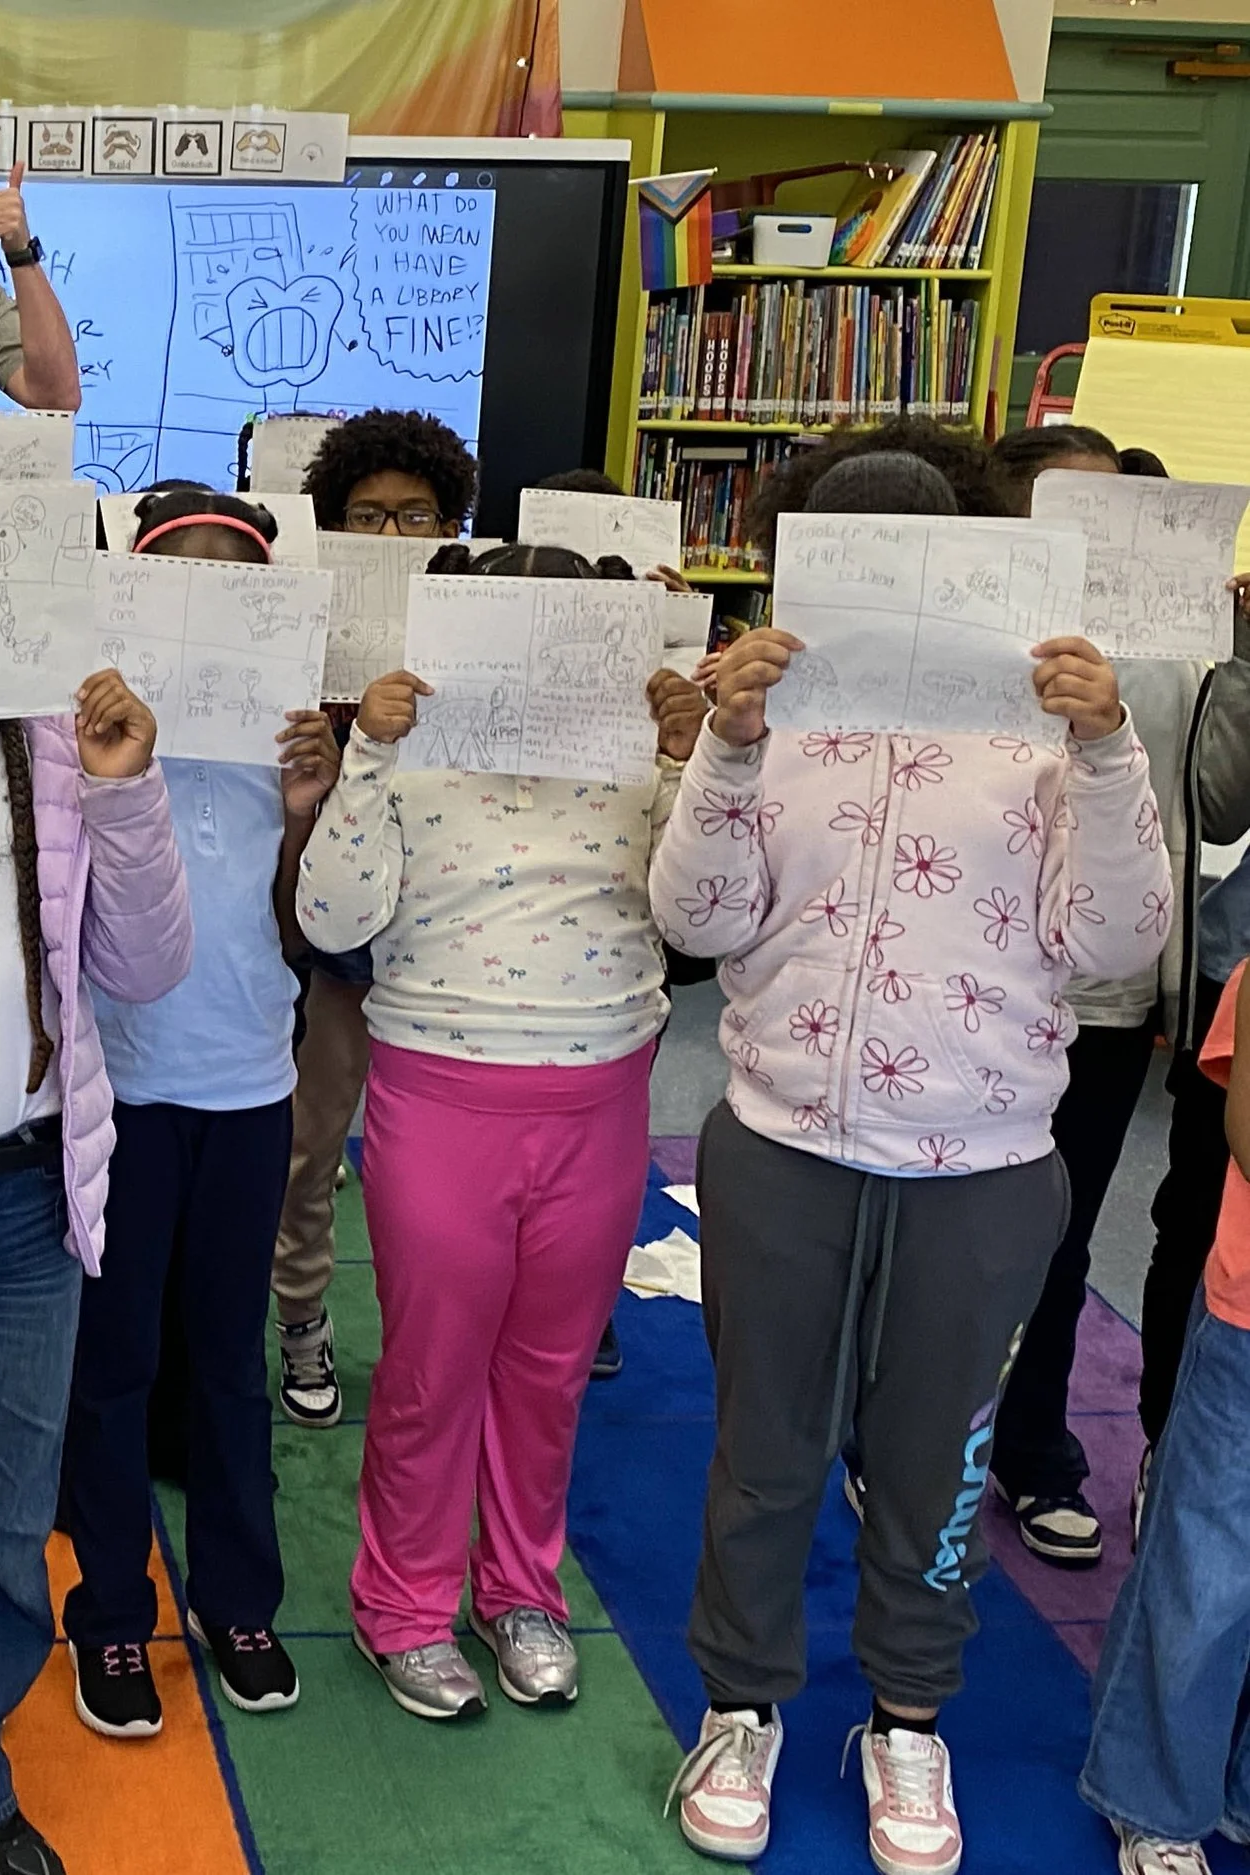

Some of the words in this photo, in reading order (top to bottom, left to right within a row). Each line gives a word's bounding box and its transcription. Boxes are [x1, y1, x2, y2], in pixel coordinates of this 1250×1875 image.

[375, 192, 443, 216] WHAT
[455, 195, 478, 214] DO
[374, 223, 410, 243] YOU
[421, 224, 481, 247] MEAN
[374, 254, 379, 273] I
[393, 251, 468, 278] HAVE
[371, 286, 385, 306] A
[397, 281, 480, 307] LIBRARY
[703, 339, 716, 396] HOOPS
[717, 338, 729, 395] HOOPS
